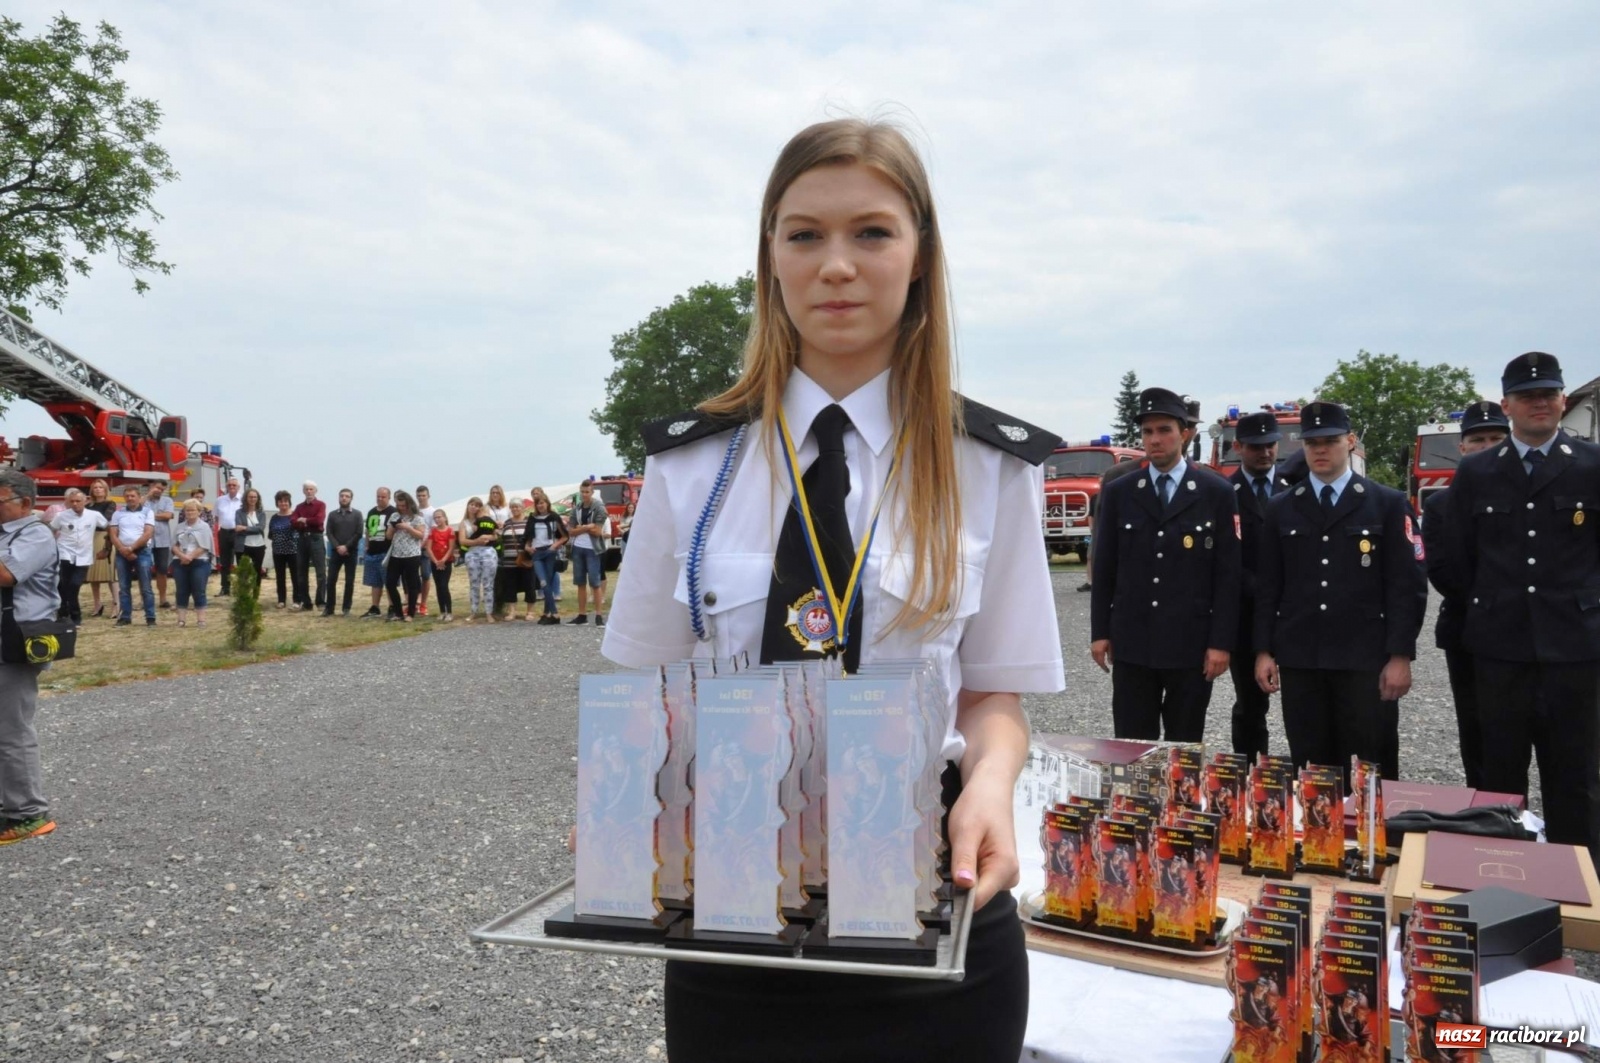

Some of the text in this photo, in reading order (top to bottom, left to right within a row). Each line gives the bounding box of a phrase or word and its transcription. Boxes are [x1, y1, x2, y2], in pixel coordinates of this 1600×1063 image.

[1276, 901, 1289, 909] 130
[1266, 913, 1278, 921] 130
[1351, 911, 1363, 919] 130
[1260, 926, 1273, 935] 130
[1344, 925, 1357, 933] 130
[1439, 922, 1453, 931] 130
[1340, 940, 1354, 948] 130
[1427, 936, 1442, 944] 130
[1250, 945, 1263, 953] 130
[1337, 956, 1352, 965] 130
[1433, 953, 1447, 962] 130
[1430, 975, 1446, 984] 130
[1432, 985, 1469, 995] Krzanowice
